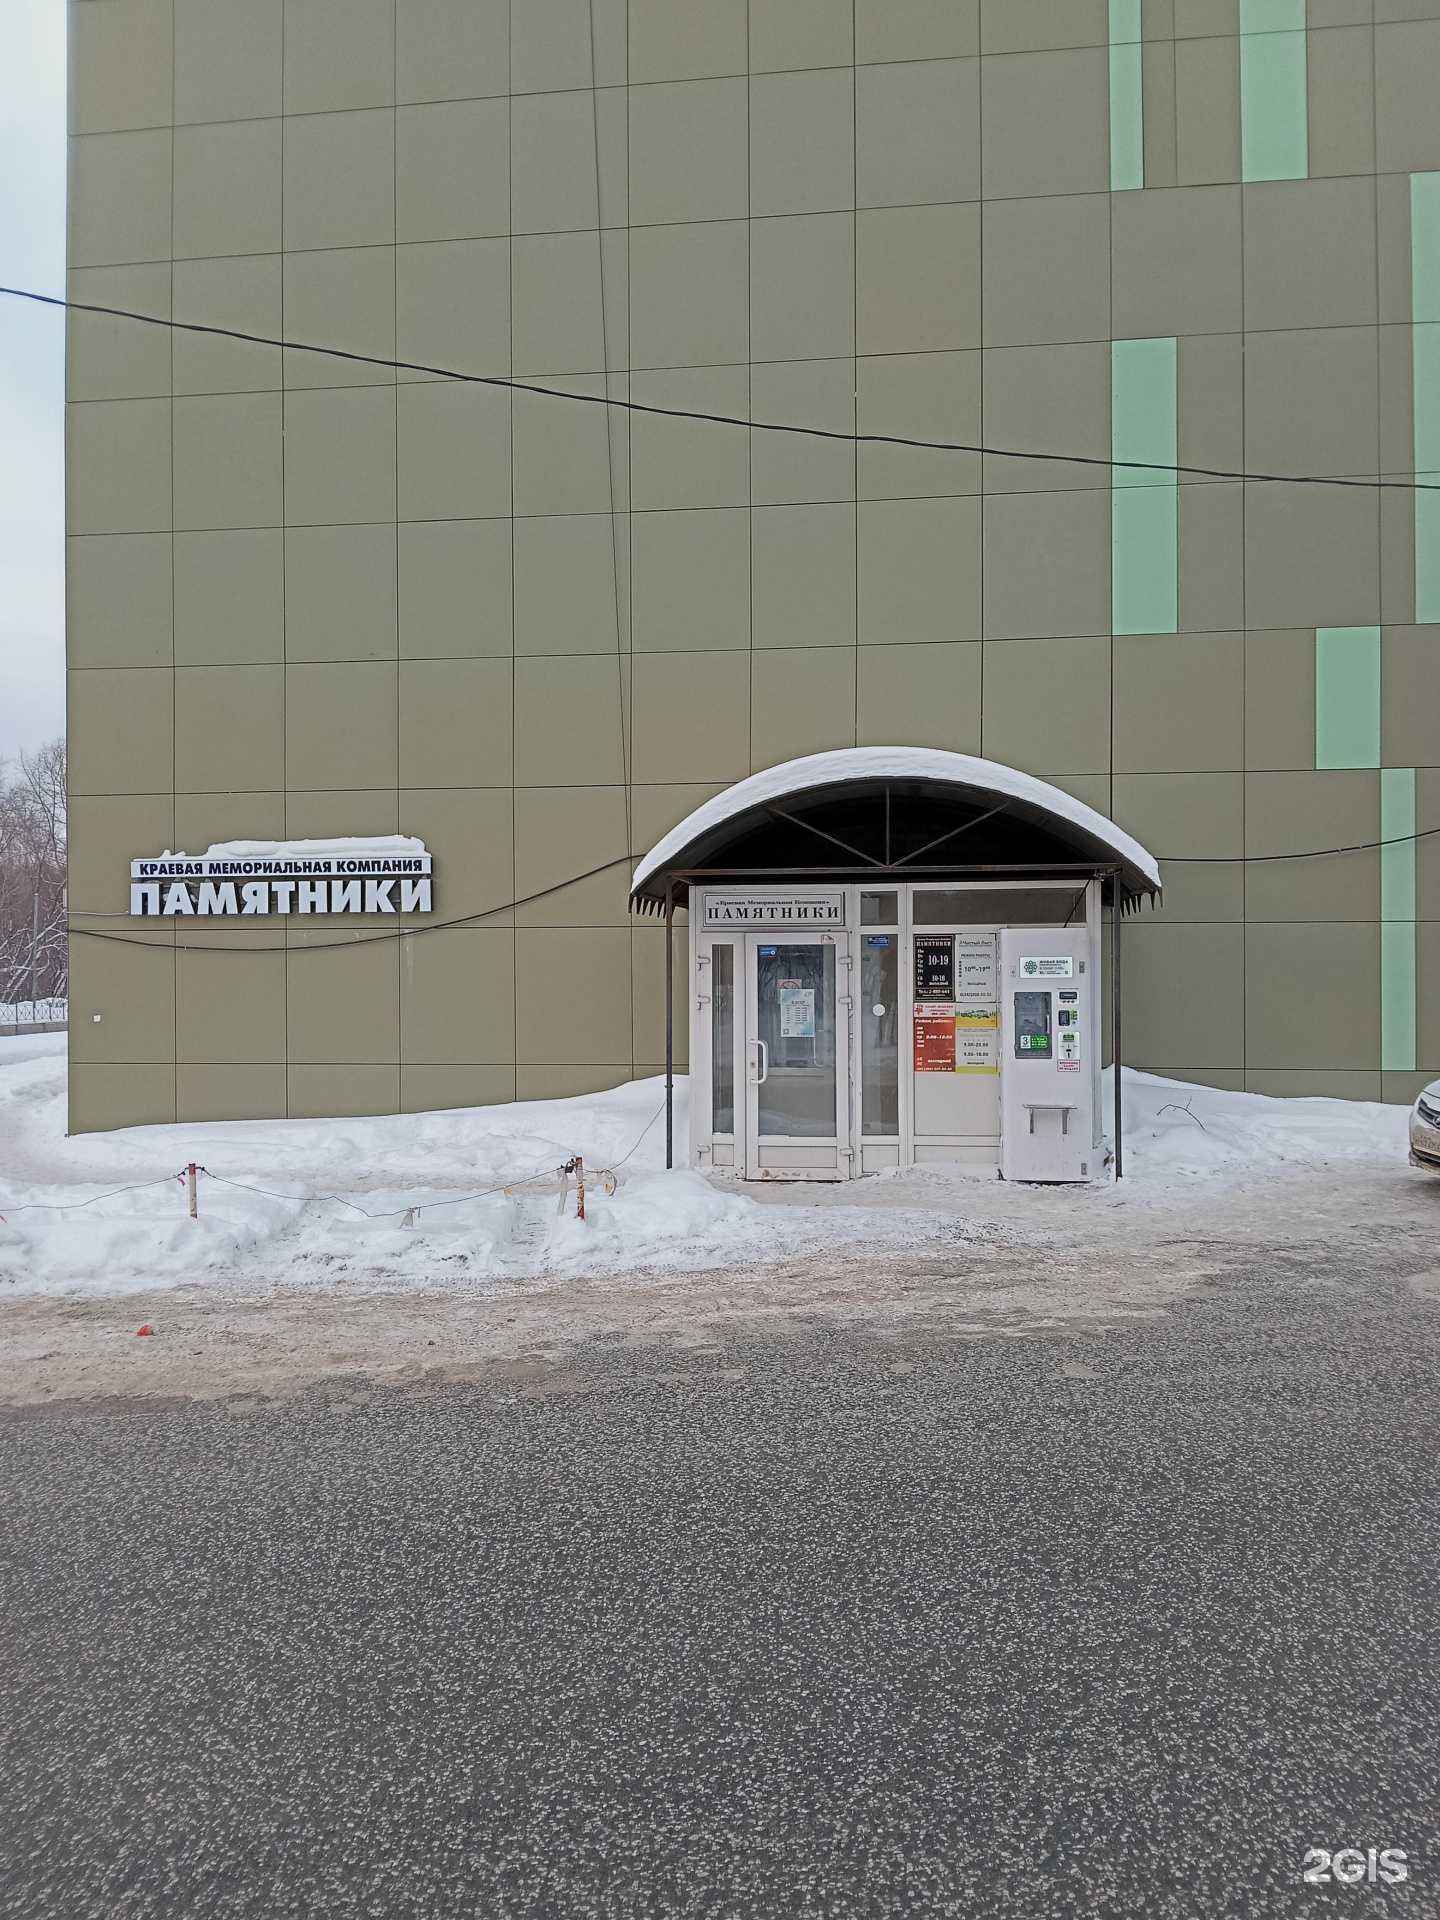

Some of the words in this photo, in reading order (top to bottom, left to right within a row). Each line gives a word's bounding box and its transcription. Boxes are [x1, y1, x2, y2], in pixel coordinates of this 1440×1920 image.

[140, 863, 203, 875] КРАЕВАЯ
[208, 861, 332, 874] МЕМОРИАЛЬНАЯ
[336, 860, 423, 873] КОМПАНИЯ
[130, 880, 432, 915] ПАМЯТНИКИ
[707, 906, 840, 919] ПАМЯТНИКИ
[928, 954, 949, 966] 10-19
